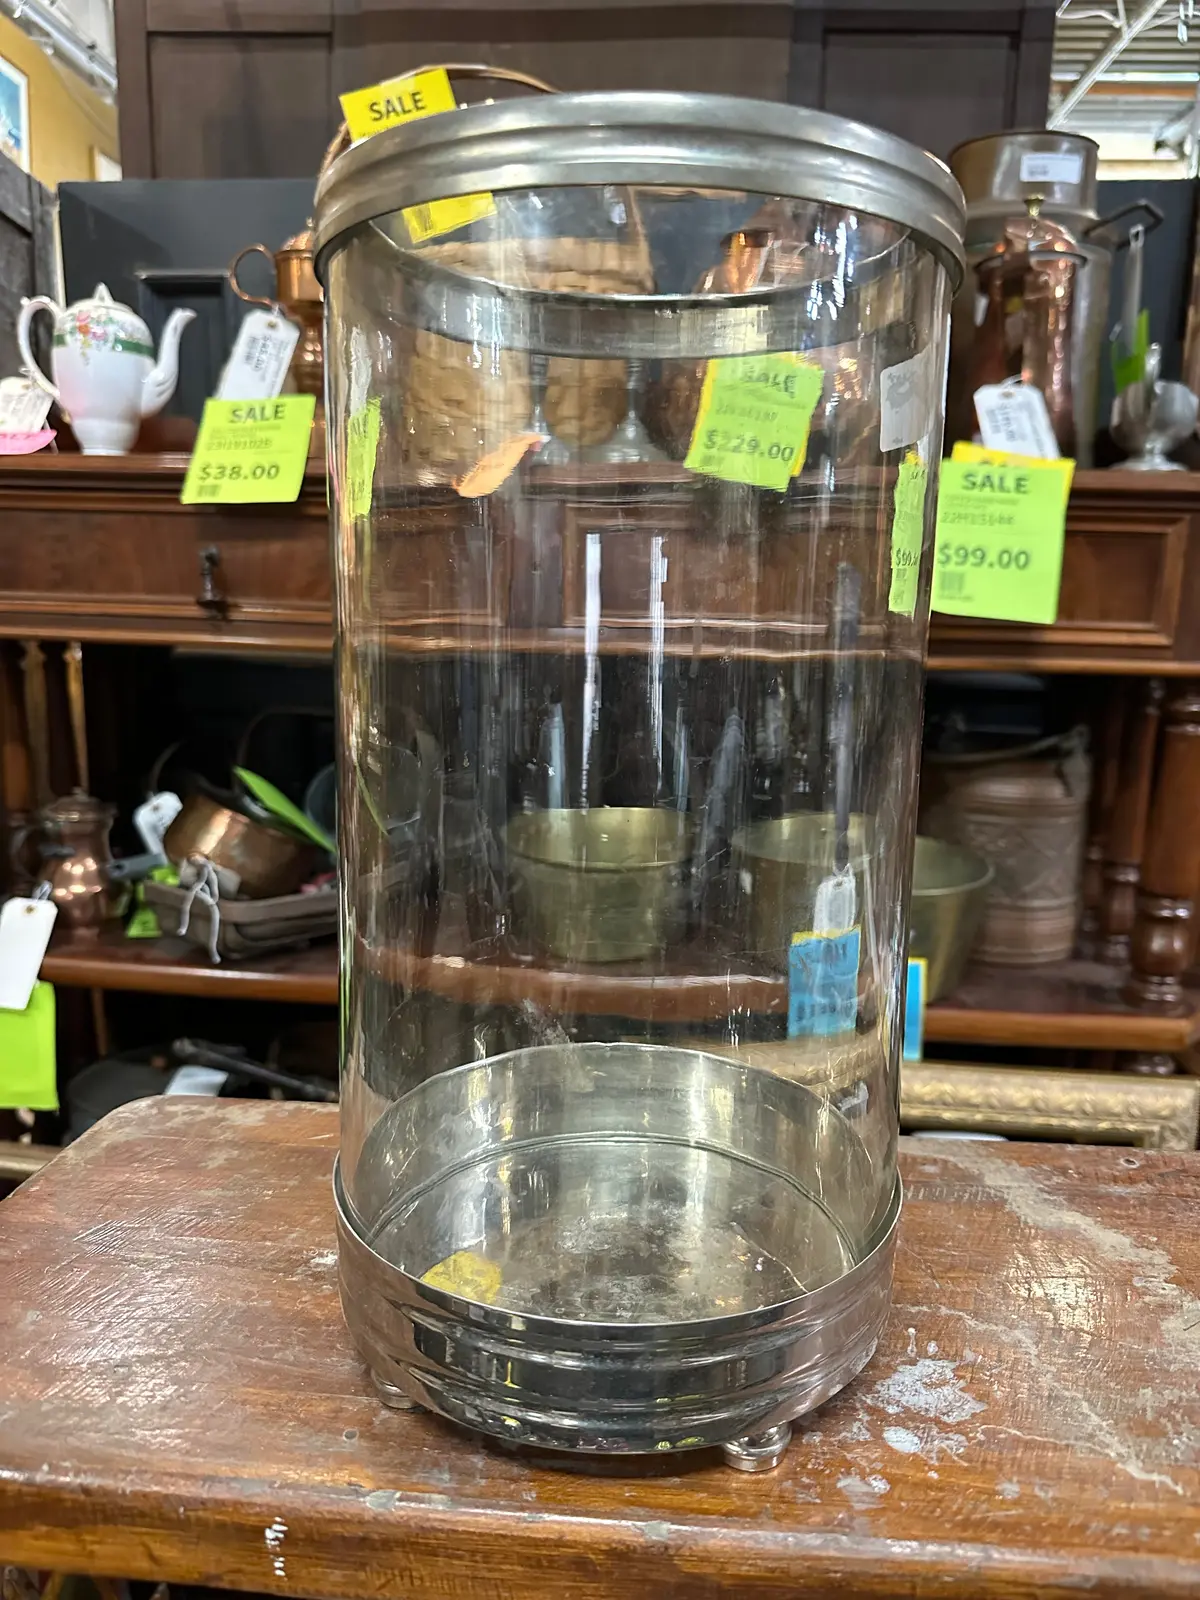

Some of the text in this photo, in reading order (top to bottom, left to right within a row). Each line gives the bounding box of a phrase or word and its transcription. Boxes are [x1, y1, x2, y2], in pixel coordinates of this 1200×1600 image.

[369, 91, 427, 121] SALE
[740, 370, 796, 398] SALE
[228, 403, 286, 424] SALE
[198, 464, 280, 481] $38.00
[961, 472, 1030, 495] SALE
[938, 543, 1031, 570] $99.00
